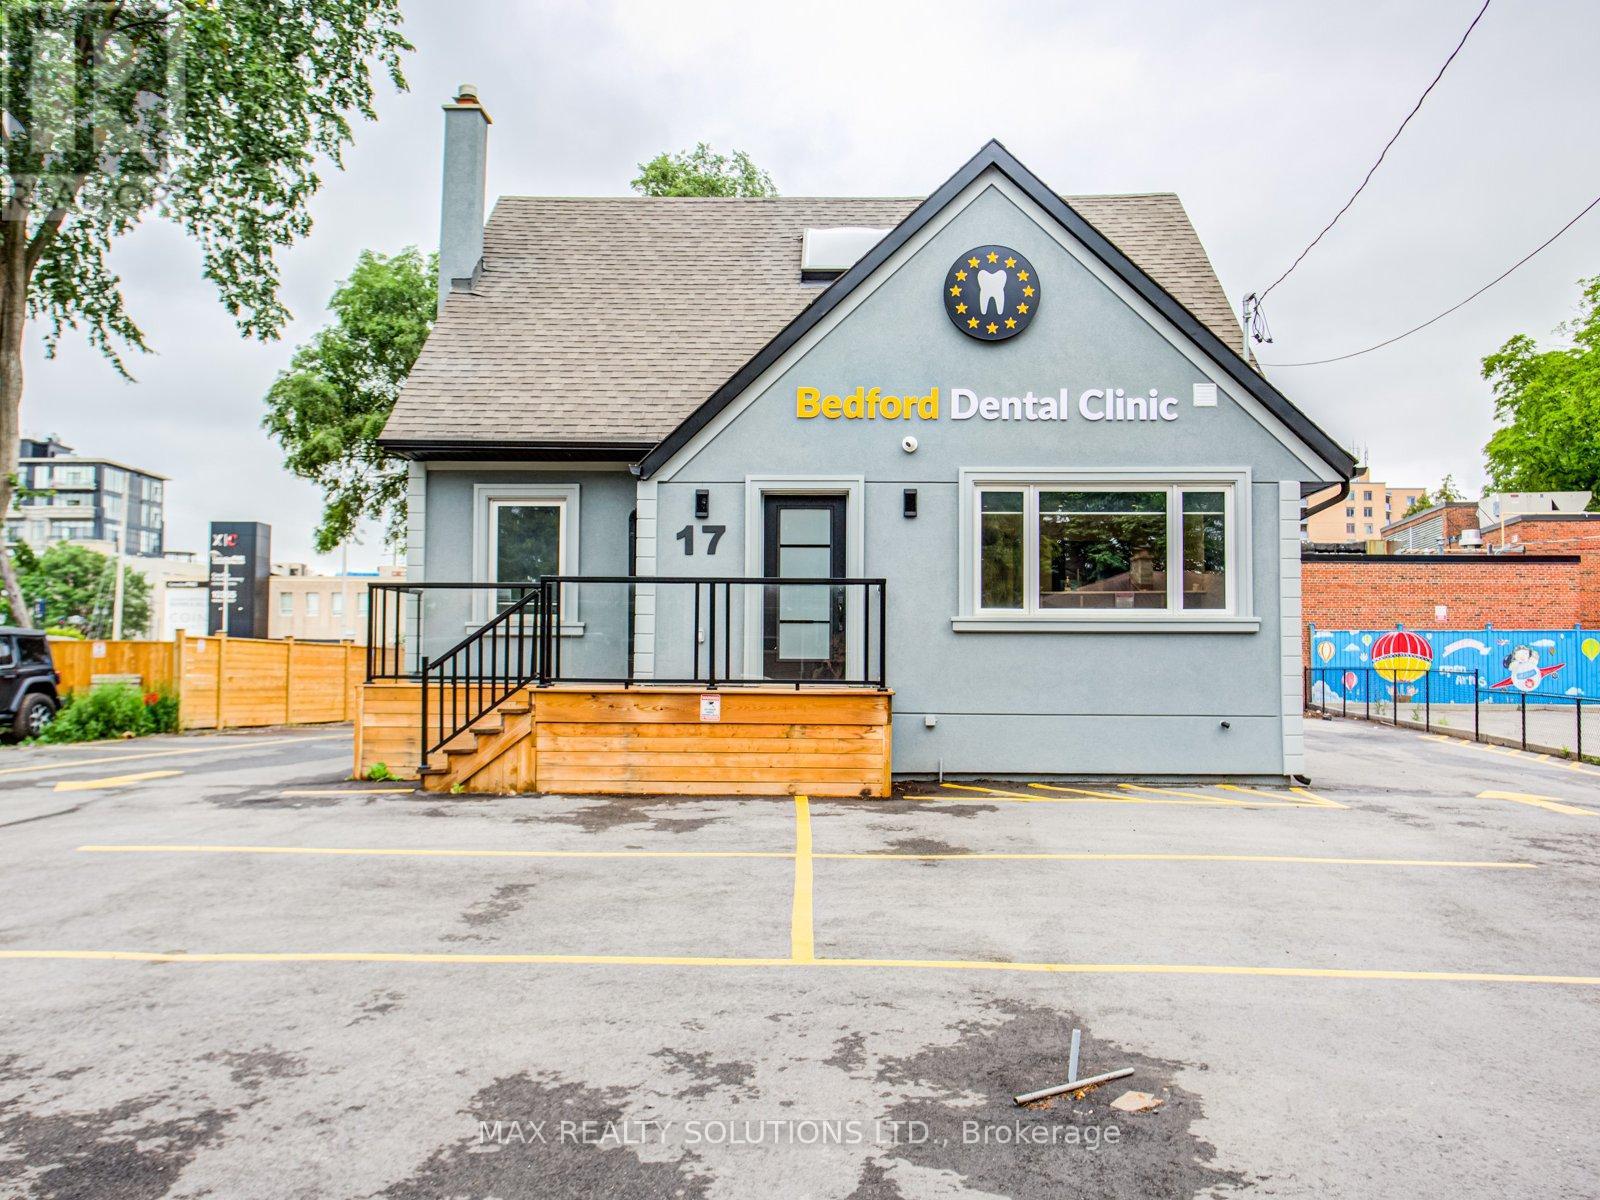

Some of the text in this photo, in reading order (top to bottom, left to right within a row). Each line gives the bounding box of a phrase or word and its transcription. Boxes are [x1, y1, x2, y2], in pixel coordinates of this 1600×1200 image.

[796, 386, 1179, 421] Bedford Dental Clinic
[676, 524, 726, 556] 17
